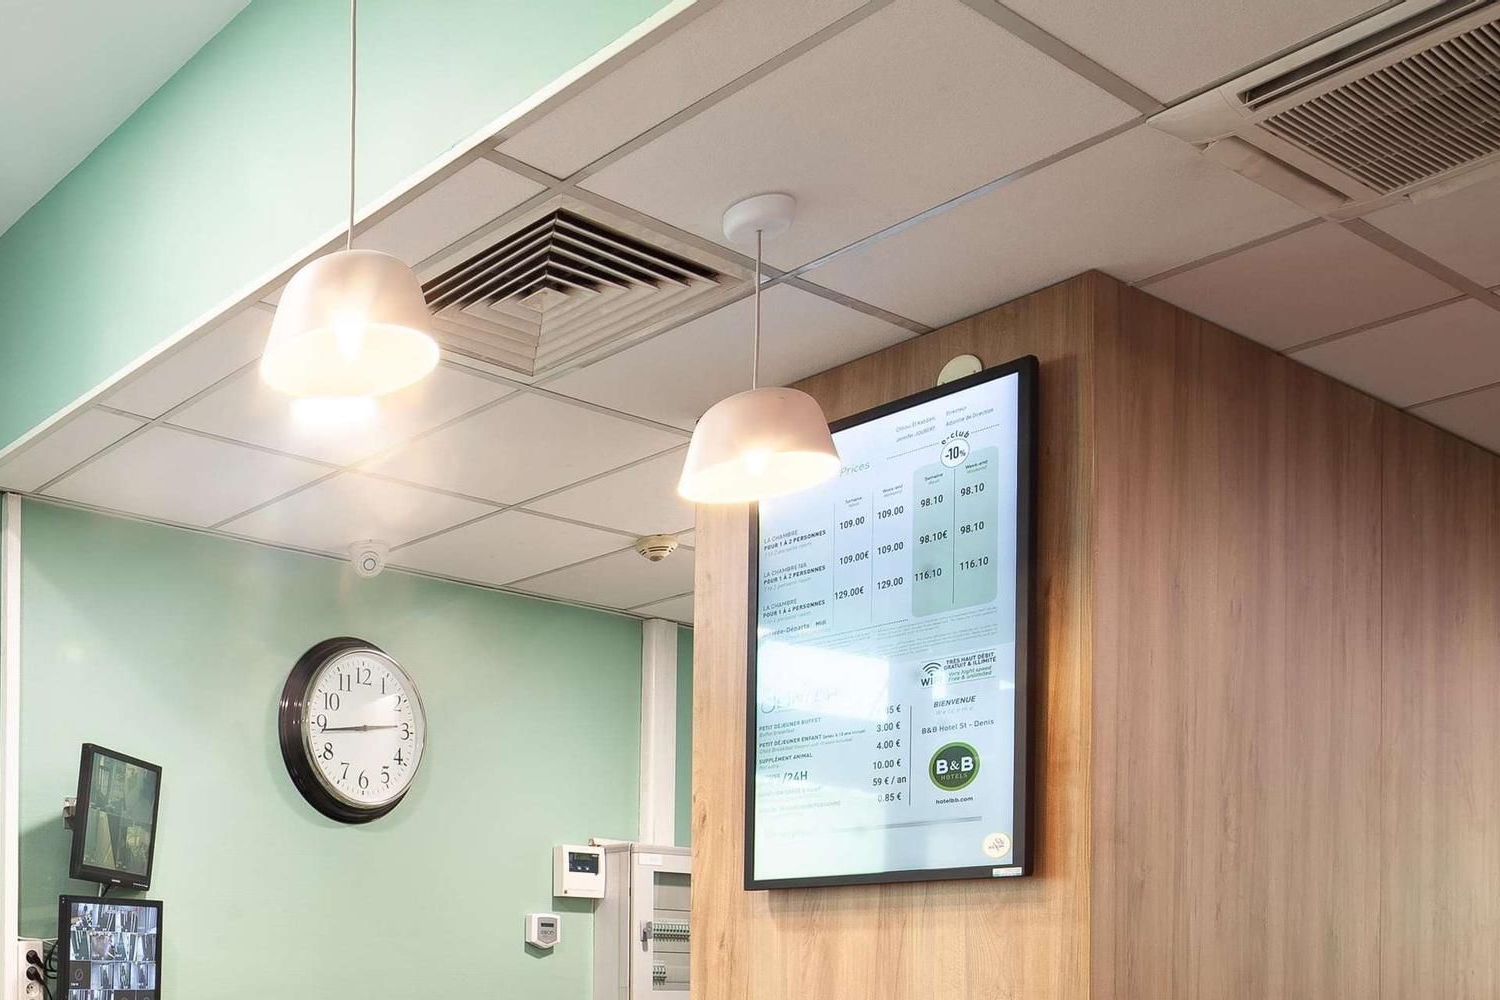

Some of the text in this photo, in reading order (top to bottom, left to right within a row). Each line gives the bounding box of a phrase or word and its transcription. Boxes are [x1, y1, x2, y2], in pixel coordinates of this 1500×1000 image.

[941, 430, 970, 445] e-club
[960, 482, 985, 496] 98.10
[920, 494, 944, 508] 98.10
[877, 505, 904, 519] 109.00
[839, 516, 865, 529] 109.00
[960, 521, 985, 535] 98.10
[793, 529, 826, 543] PERSONNES
[919, 530, 948, 545] 98.10€
[877, 541, 904, 555] 109.00
[839, 550, 869, 565] 109.00€
[960, 556, 989, 570] 116.10
[792, 565, 826, 578] PERSONNES
[914, 567, 942, 581] 116.10
[877, 576, 904, 590] 129.00
[834, 586, 864, 600] 129.00€
[792, 600, 825, 612] PERSONNES
[339, 673, 352, 692] 11
[356, 667, 372, 686] 12
[324, 692, 340, 711] 10
[393, 695, 402, 712] 2
[933, 695, 976, 708] BIENVENUE
[317, 714, 328, 734] 9
[876, 723, 893, 732] 3.00
[921, 726, 938, 735] B&B
[939, 723, 958, 733] Hotel
[974, 718, 995, 728] Denis
[401, 723, 410, 740] 3
[801, 734, 821, 742] ENFANT
[323, 742, 334, 760] 8
[876, 741, 893, 749] 4.00
[393, 747, 404, 765] 4
[793, 752, 813, 760] ANIMAL
[341, 762, 350, 780] 7
[873, 759, 894, 769] 10.00
[936, 756, 973, 775] B&B
[358, 769, 369, 789] 6
[381, 766, 390, 784] 5
[872, 777, 882, 786] 59
[896, 775, 907, 783] an
[940, 773, 968, 781] HOTELS
[935, 796, 973, 805] hotelbb.com
